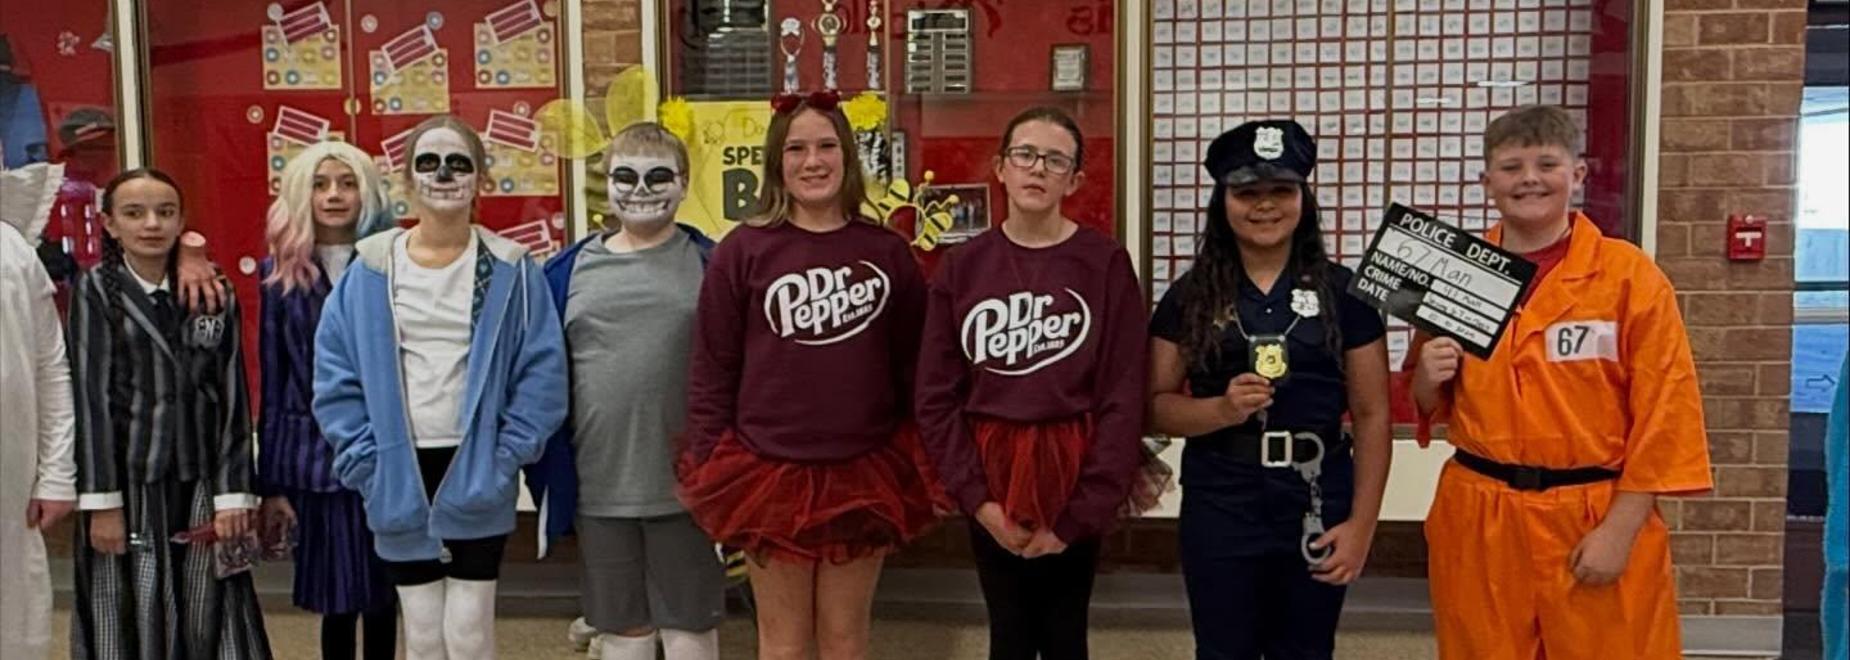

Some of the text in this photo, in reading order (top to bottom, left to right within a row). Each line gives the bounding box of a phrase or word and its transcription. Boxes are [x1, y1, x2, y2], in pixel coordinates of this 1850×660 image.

[1397, 239, 1473, 287] 67 Man
[1400, 213, 1512, 275] POLICE DEPT.
[806, 266, 852, 301] Dr
[1363, 265, 1403, 291] CRIME
[1371, 251, 1430, 288] NAME/NO.
[764, 272, 882, 338] Pepper
[1357, 277, 1390, 302] DATE
[1008, 291, 1054, 330] Dr
[961, 298, 1082, 366] Pepper
[1557, 325, 1590, 357] 67
